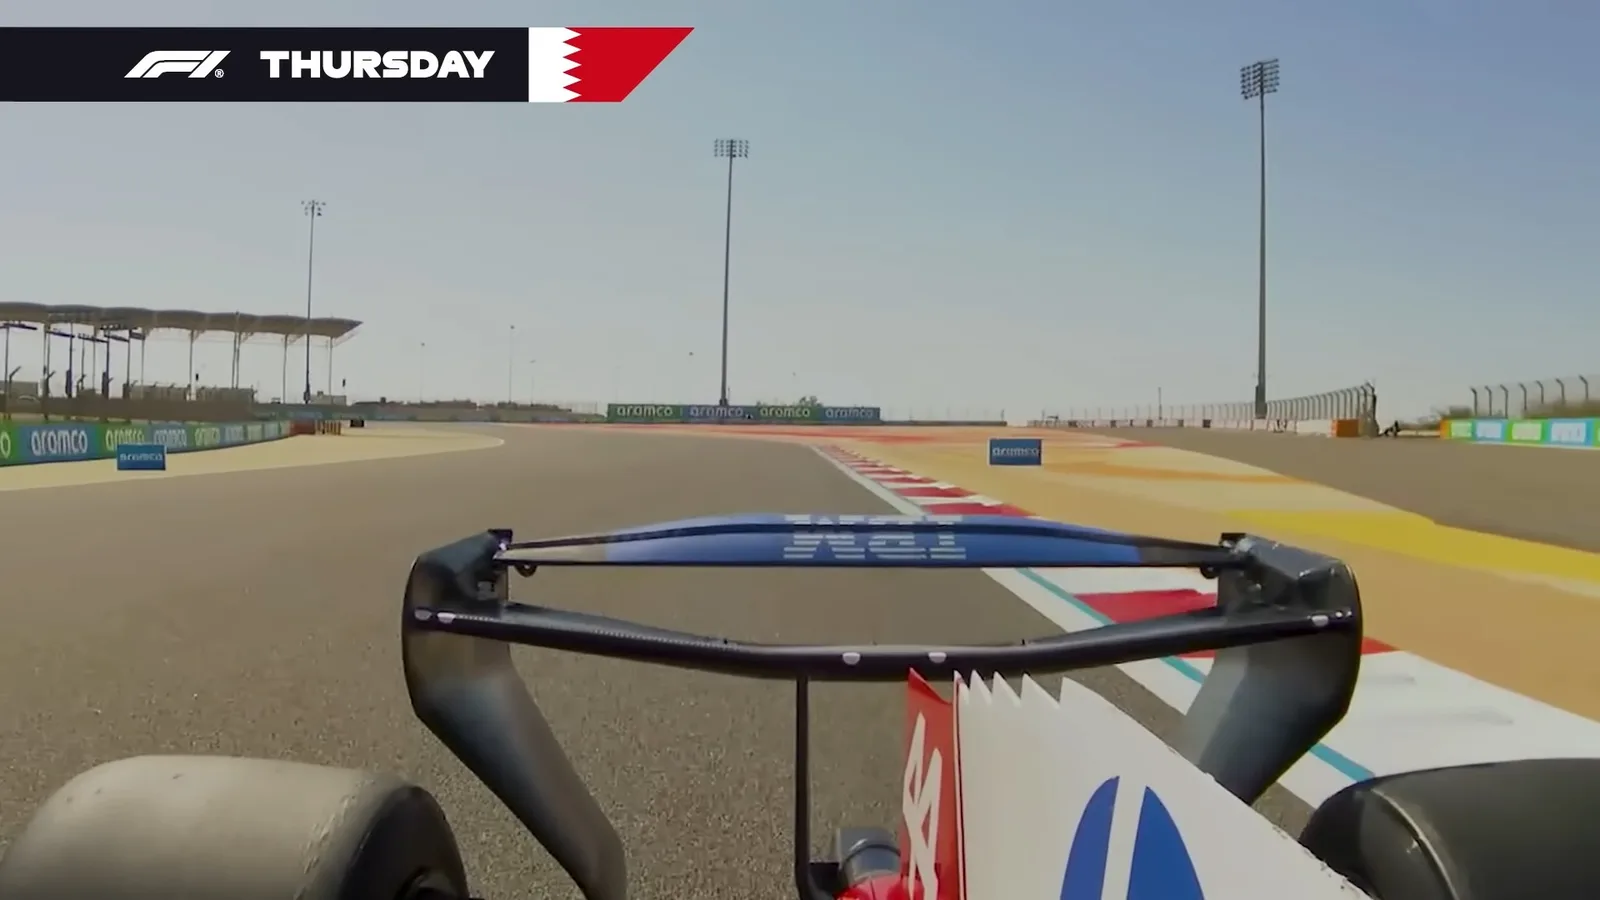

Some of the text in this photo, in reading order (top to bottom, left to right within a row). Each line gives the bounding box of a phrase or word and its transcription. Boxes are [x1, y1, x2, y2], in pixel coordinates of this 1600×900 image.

[616, 404, 674, 417] aramco
[689, 405, 744, 418] aramco
[759, 405, 811, 418] aramco
[825, 407, 874, 418] aramco
[31, 428, 89, 457] aramco
